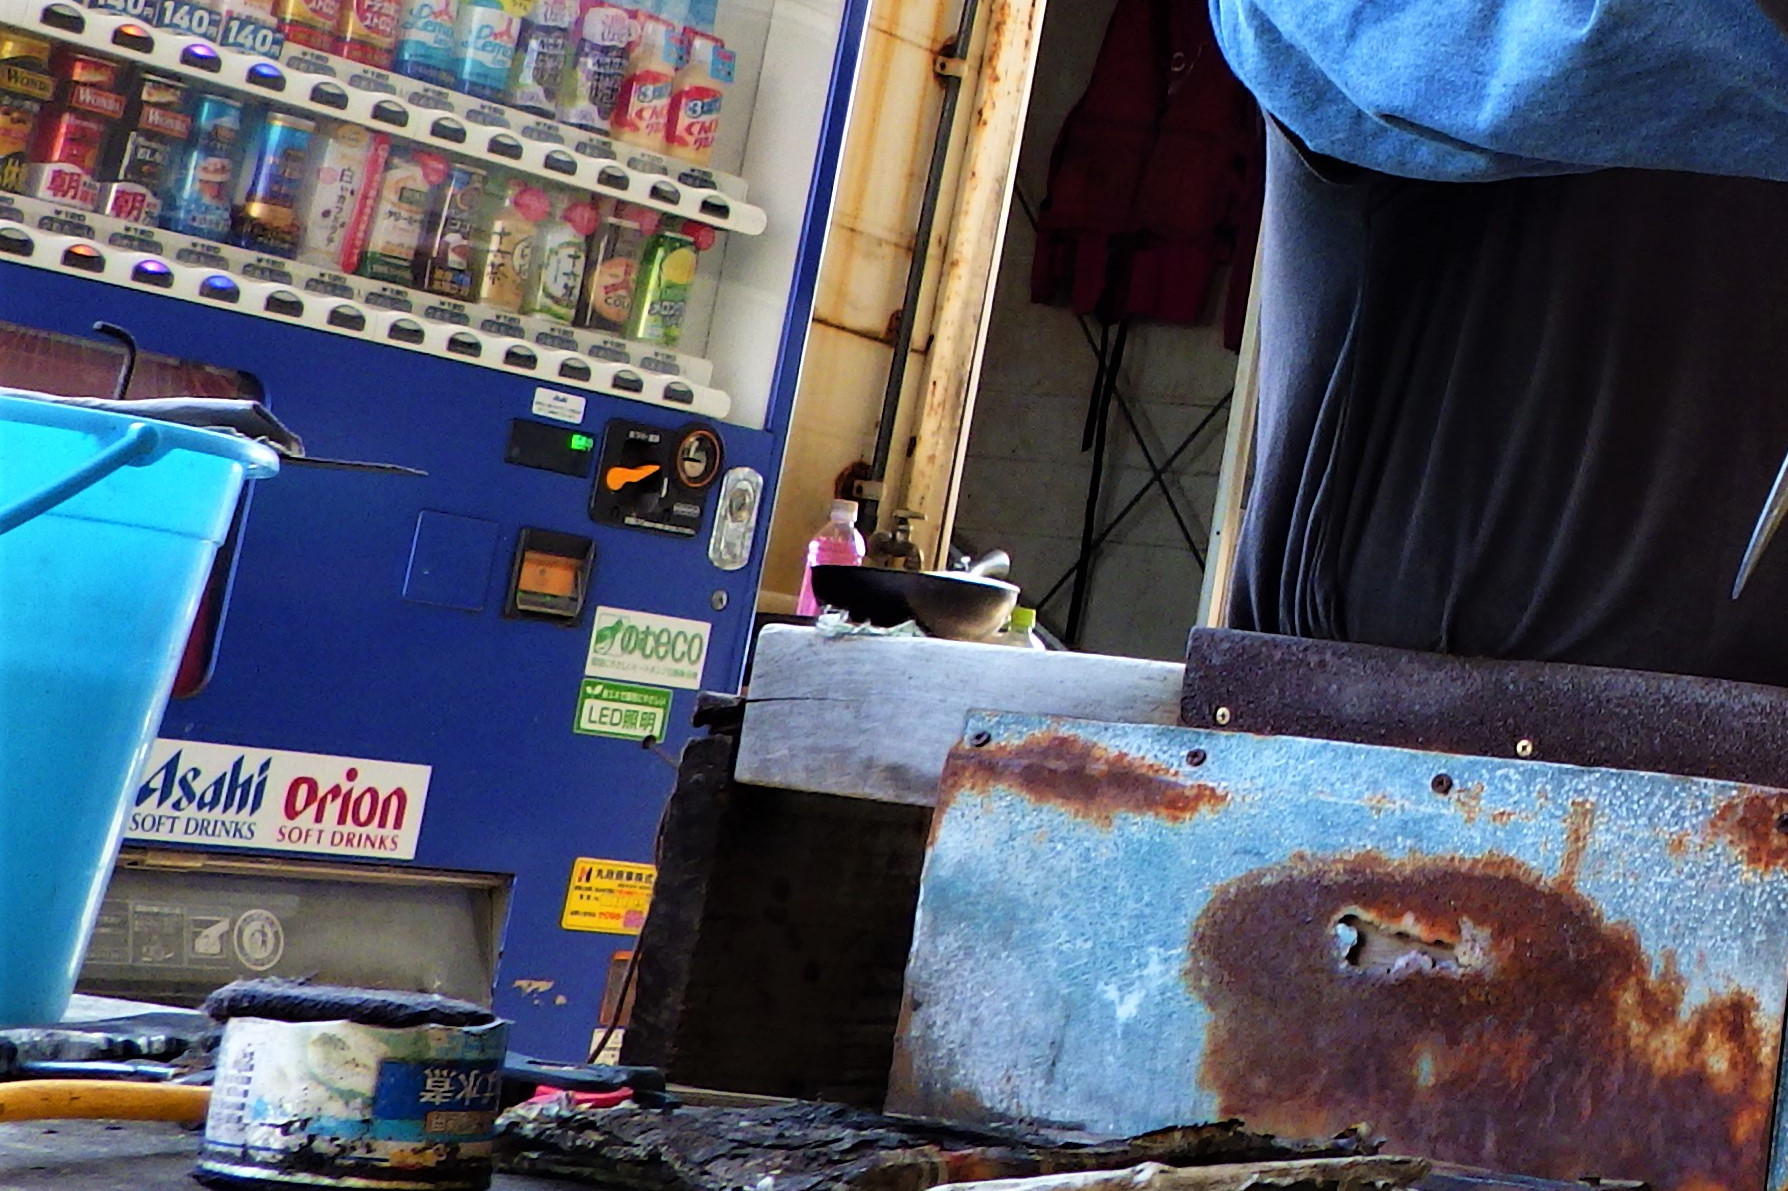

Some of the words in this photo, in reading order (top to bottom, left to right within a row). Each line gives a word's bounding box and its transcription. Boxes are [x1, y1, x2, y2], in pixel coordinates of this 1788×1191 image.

[135, 749, 272, 816] Asahi
[284, 768, 407, 830] Orion
[129, 813, 181, 833] SOFT
[183, 816, 257, 841] DRINKS
[277, 824, 324, 845] SOFT
[330, 829, 399, 852] DRINKS
